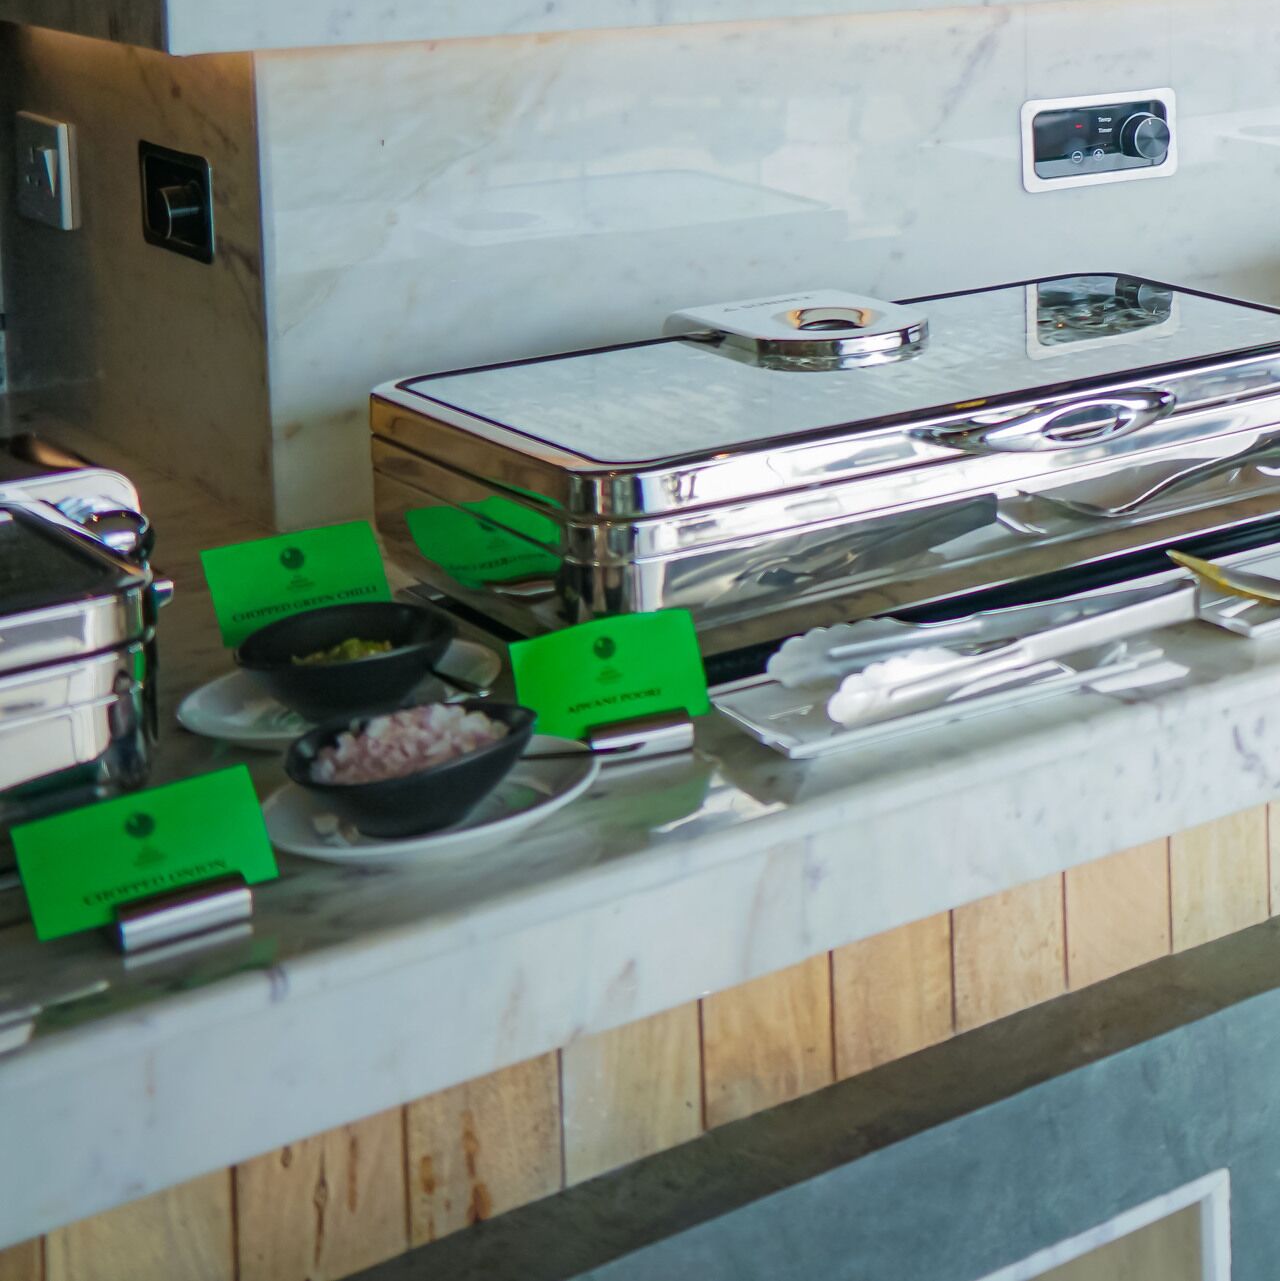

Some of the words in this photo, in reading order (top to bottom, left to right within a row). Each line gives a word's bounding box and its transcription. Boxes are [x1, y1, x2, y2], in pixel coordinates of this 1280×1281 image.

[232, 602, 291, 624] CHOPPED
[293, 594, 335, 610] GREEN
[336, 585, 378, 601] CHILLI
